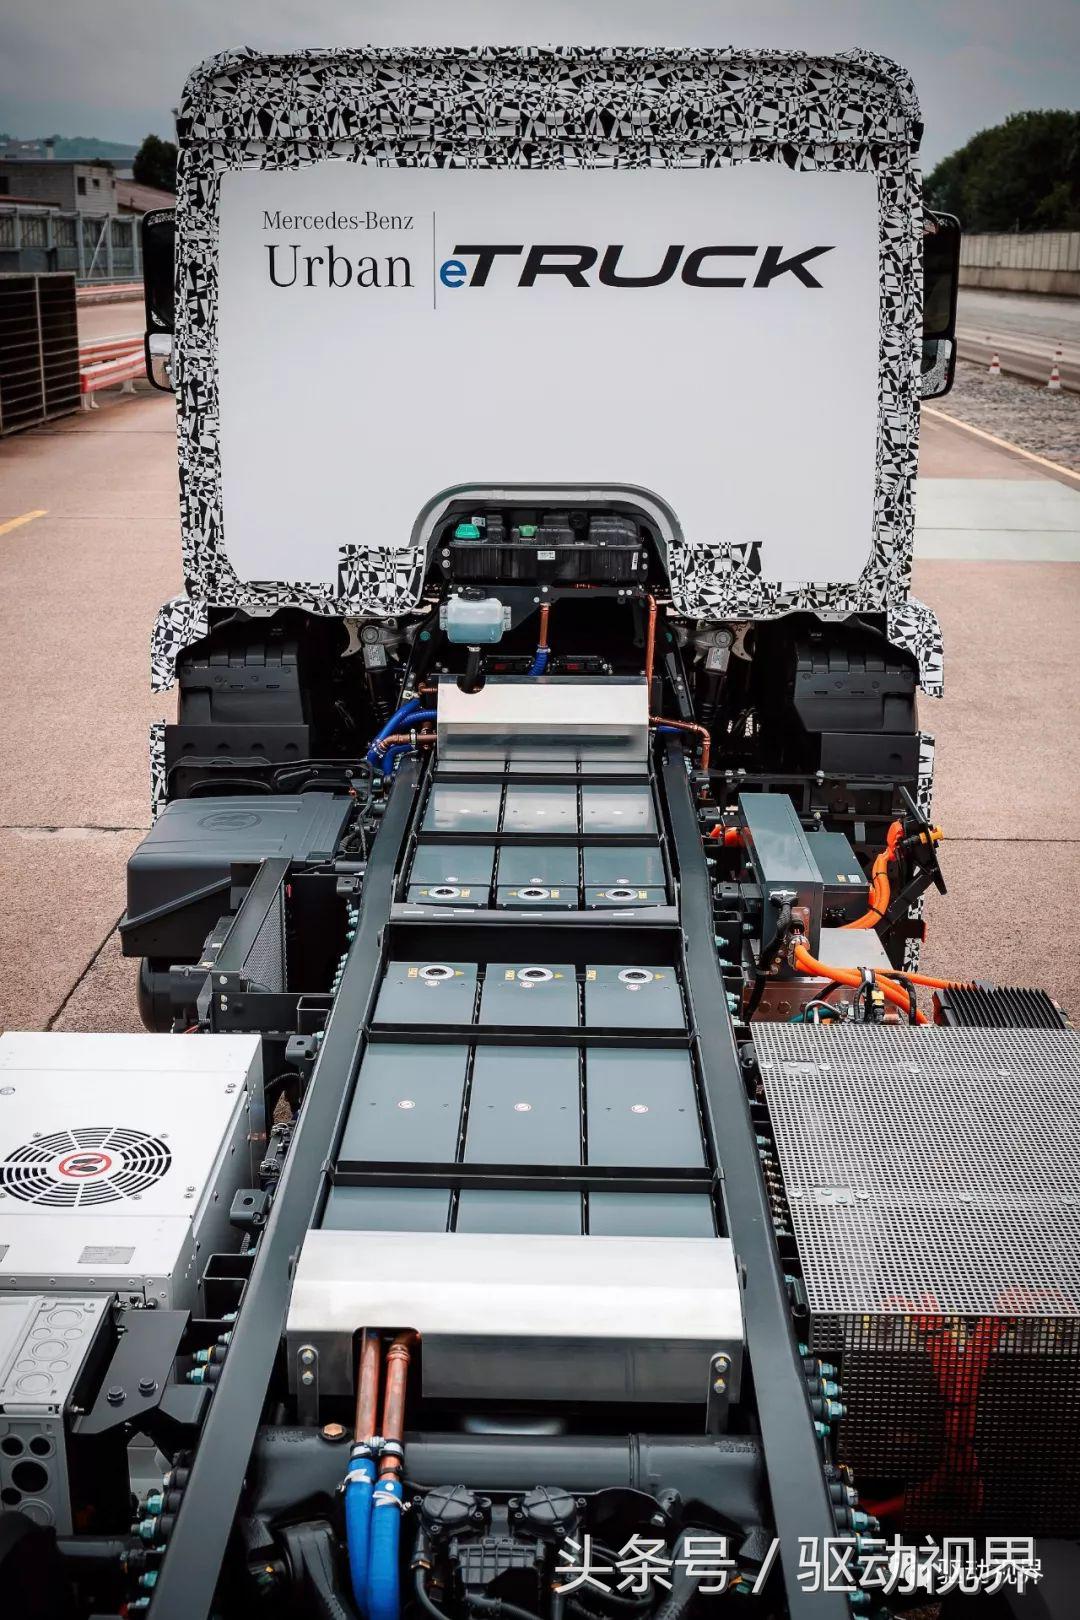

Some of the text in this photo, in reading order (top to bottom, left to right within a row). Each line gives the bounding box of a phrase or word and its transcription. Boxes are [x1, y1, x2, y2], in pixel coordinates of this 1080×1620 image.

[262, 210, 414, 230] Mercedes-Benz
[263, 244, 837, 289] Urban eTRUCK
